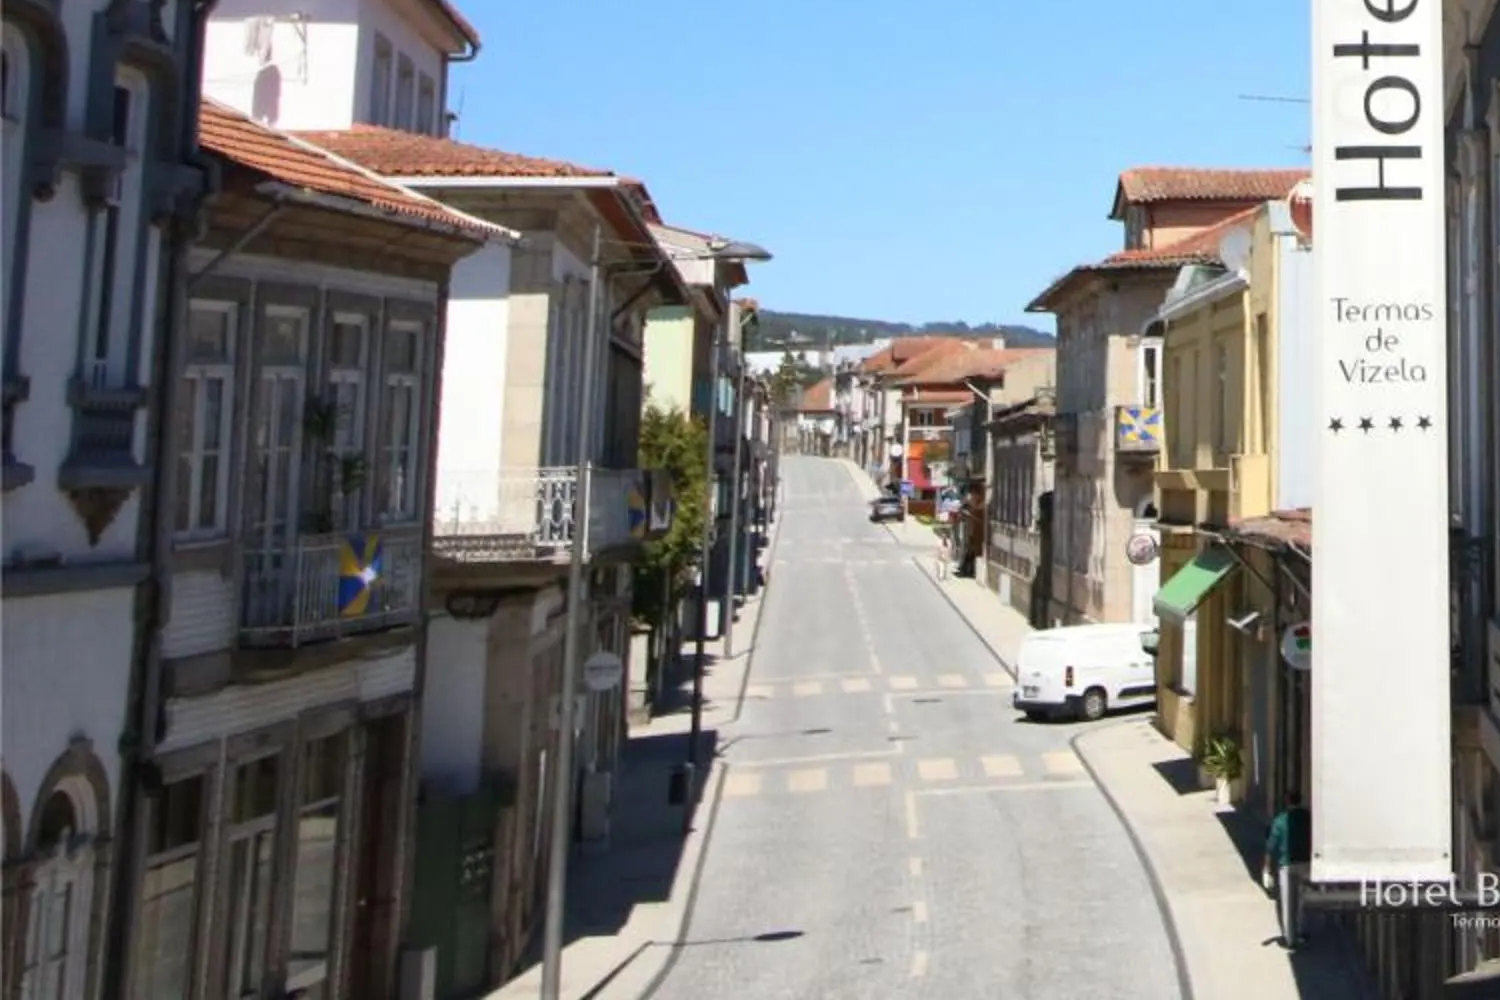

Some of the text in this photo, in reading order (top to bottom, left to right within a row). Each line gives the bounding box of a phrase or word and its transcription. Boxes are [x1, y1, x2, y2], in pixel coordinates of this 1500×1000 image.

[1331, 298, 1433, 322] Termas
[1365, 328, 1399, 351] de
[1339, 359, 1427, 383] Vizela
